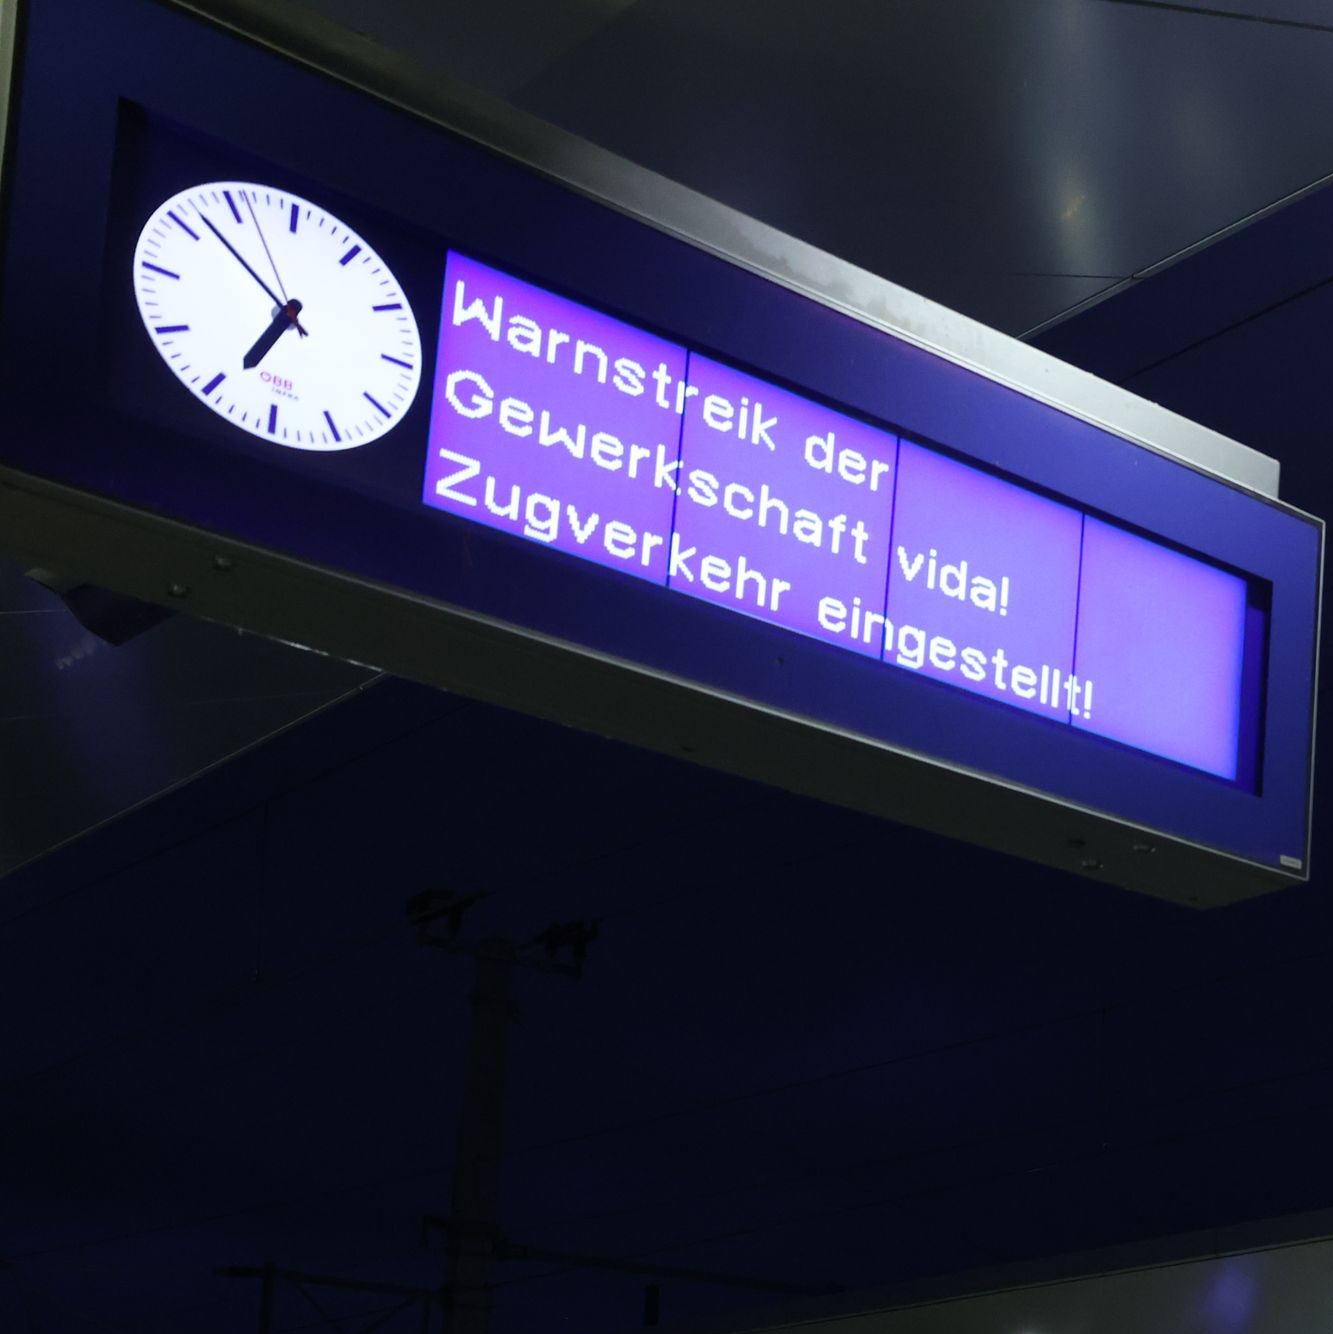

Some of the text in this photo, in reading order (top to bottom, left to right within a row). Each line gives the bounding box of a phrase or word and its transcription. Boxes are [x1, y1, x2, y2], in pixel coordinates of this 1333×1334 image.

[445, 370, 1010, 616] Gewerkschaft vida!
[452, 279, 890, 491] Warnstreik der
[436, 448, 1093, 719] Zugverkehr eingestellt!
